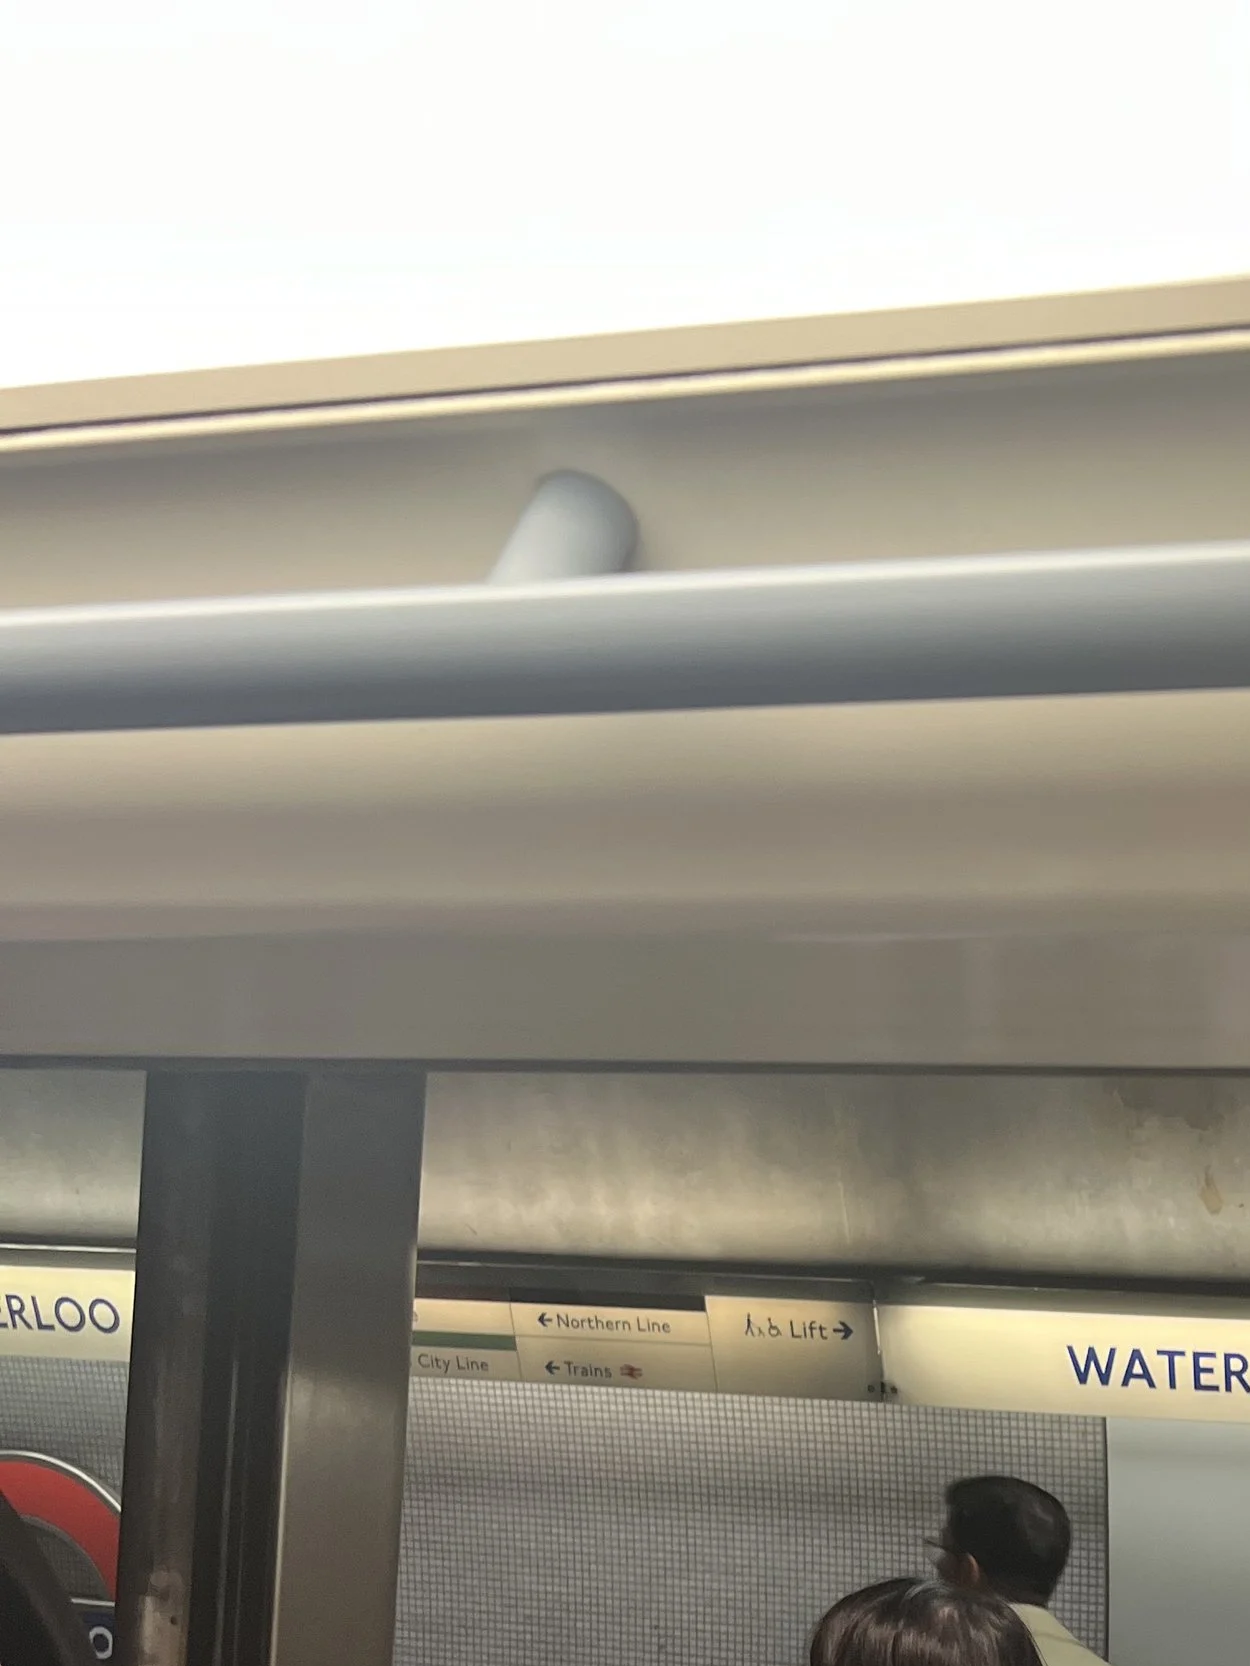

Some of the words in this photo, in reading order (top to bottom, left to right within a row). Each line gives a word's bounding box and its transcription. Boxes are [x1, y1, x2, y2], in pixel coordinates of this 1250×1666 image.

[556, 1313, 631, 1332] Northern
[636, 1316, 672, 1334] Line
[790, 1319, 828, 1340] Lift
[417, 1353, 450, 1374] City
[456, 1355, 489, 1372] Line
[563, 1360, 613, 1379] Trains
